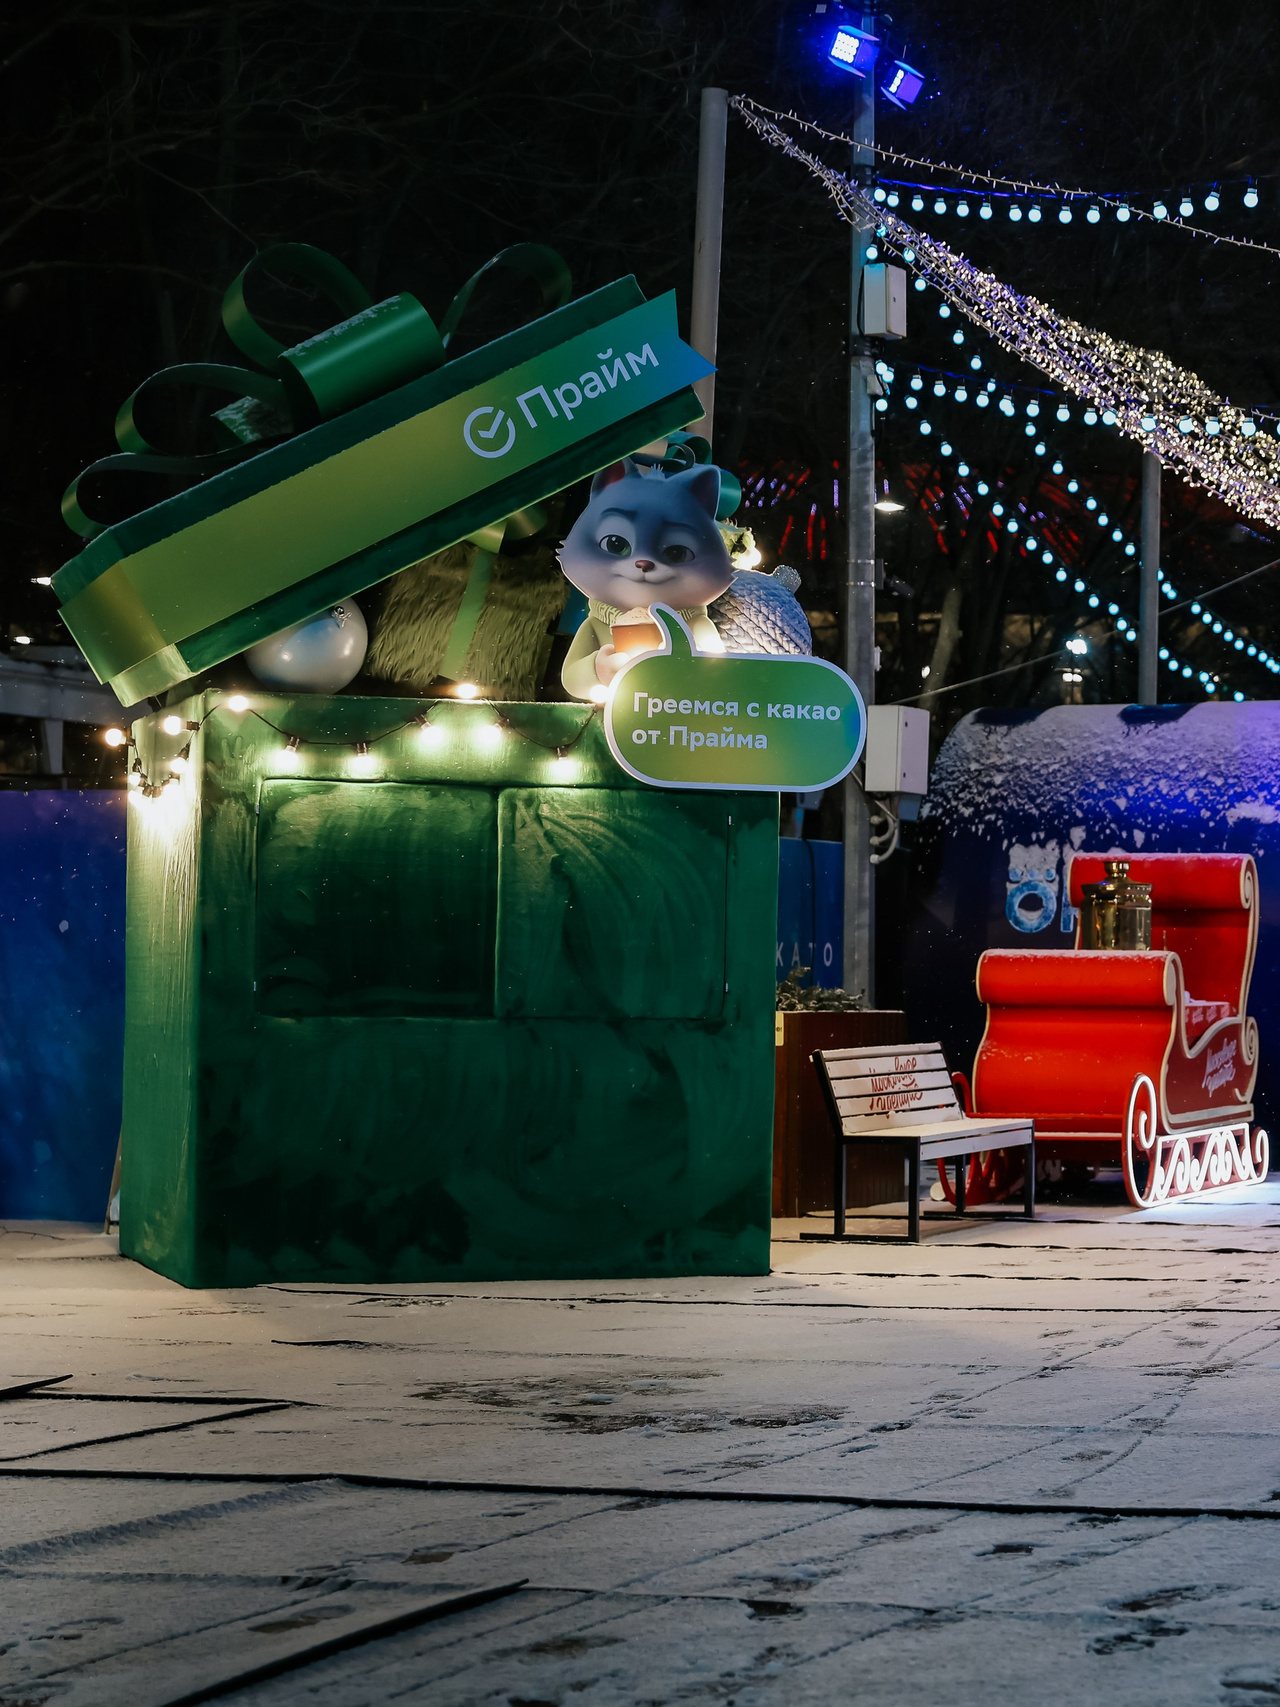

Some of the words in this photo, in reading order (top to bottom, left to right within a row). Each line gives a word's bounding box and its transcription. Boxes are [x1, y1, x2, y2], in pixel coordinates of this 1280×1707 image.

[516, 343, 659, 428] Прайм
[633, 692, 739, 718] Греемся
[747, 702, 760, 718] с
[767, 704, 841, 721] какао
[632, 728, 661, 745] от
[669, 726, 768, 751] Прайма
